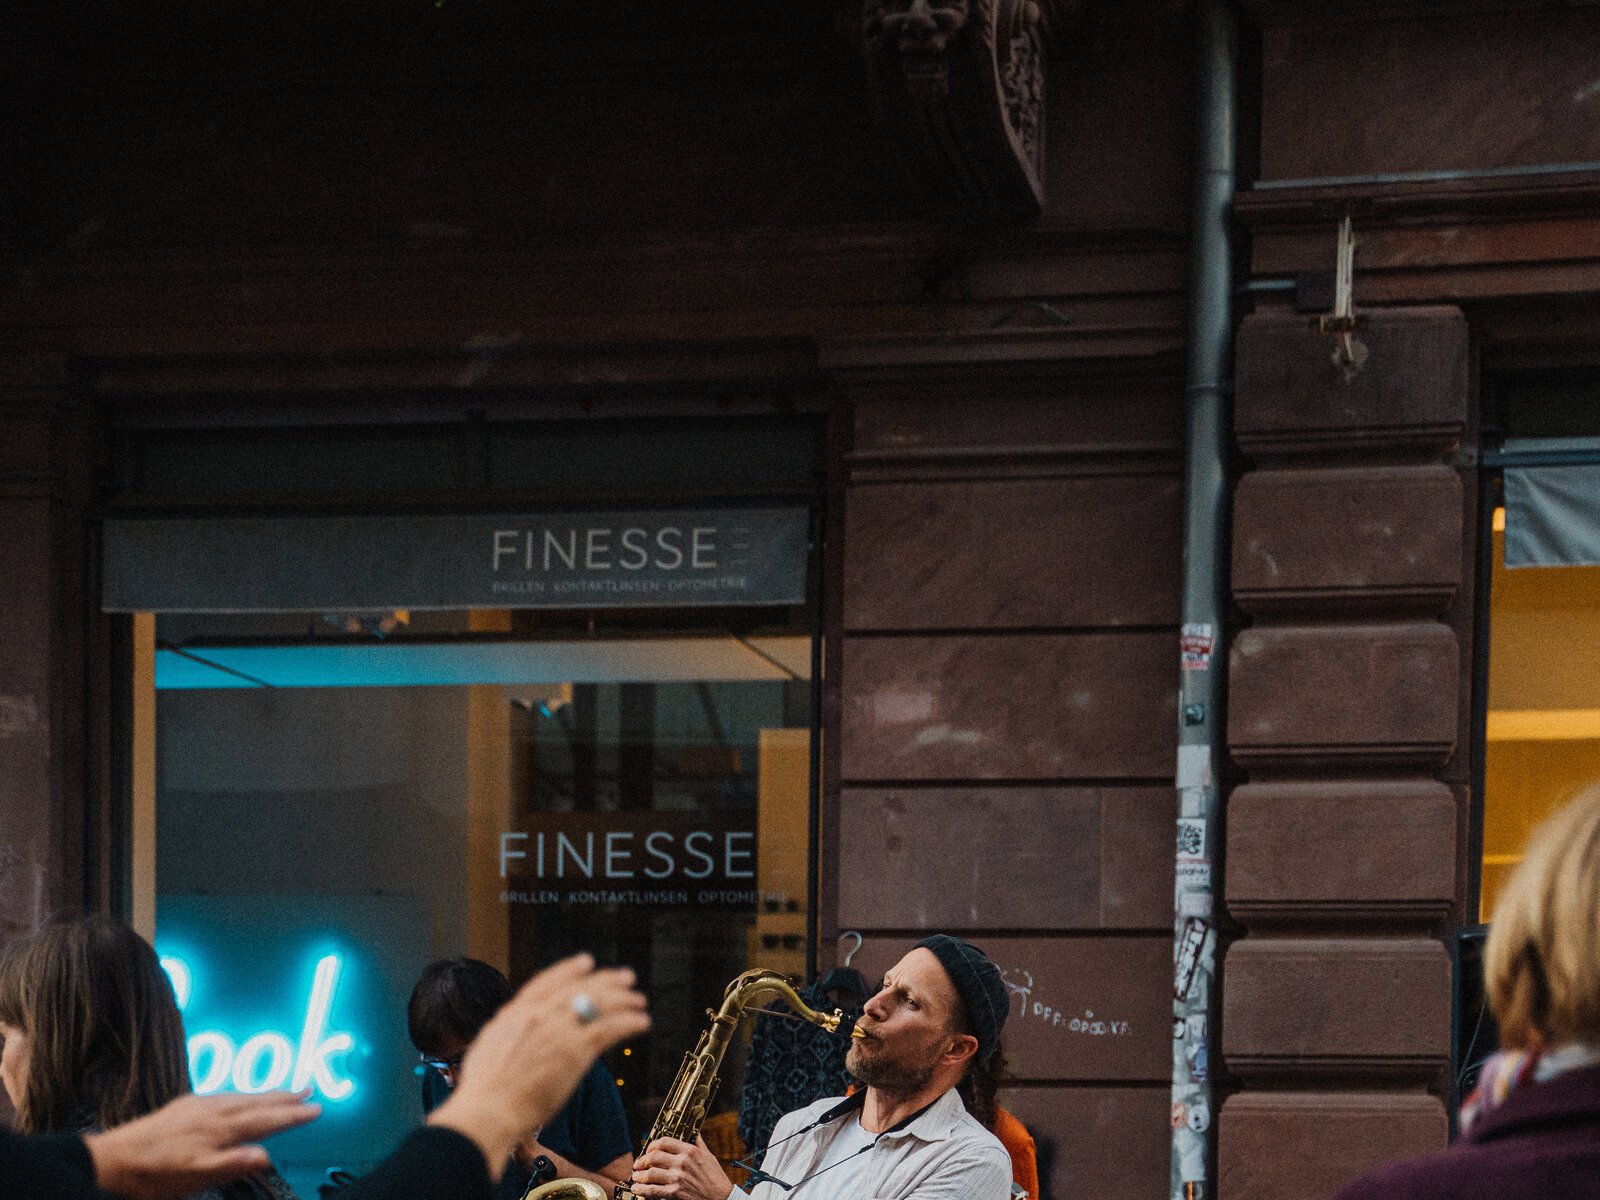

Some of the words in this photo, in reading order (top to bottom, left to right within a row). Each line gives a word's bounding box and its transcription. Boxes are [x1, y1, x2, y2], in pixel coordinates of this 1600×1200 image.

[492, 527, 718, 571] FINESSE
[500, 831, 755, 878] FINESSE
[499, 890, 559, 904] BRILLEN
[568, 890, 689, 904] KONTAKTLINSEN
[160, 954, 353, 1099] ook
